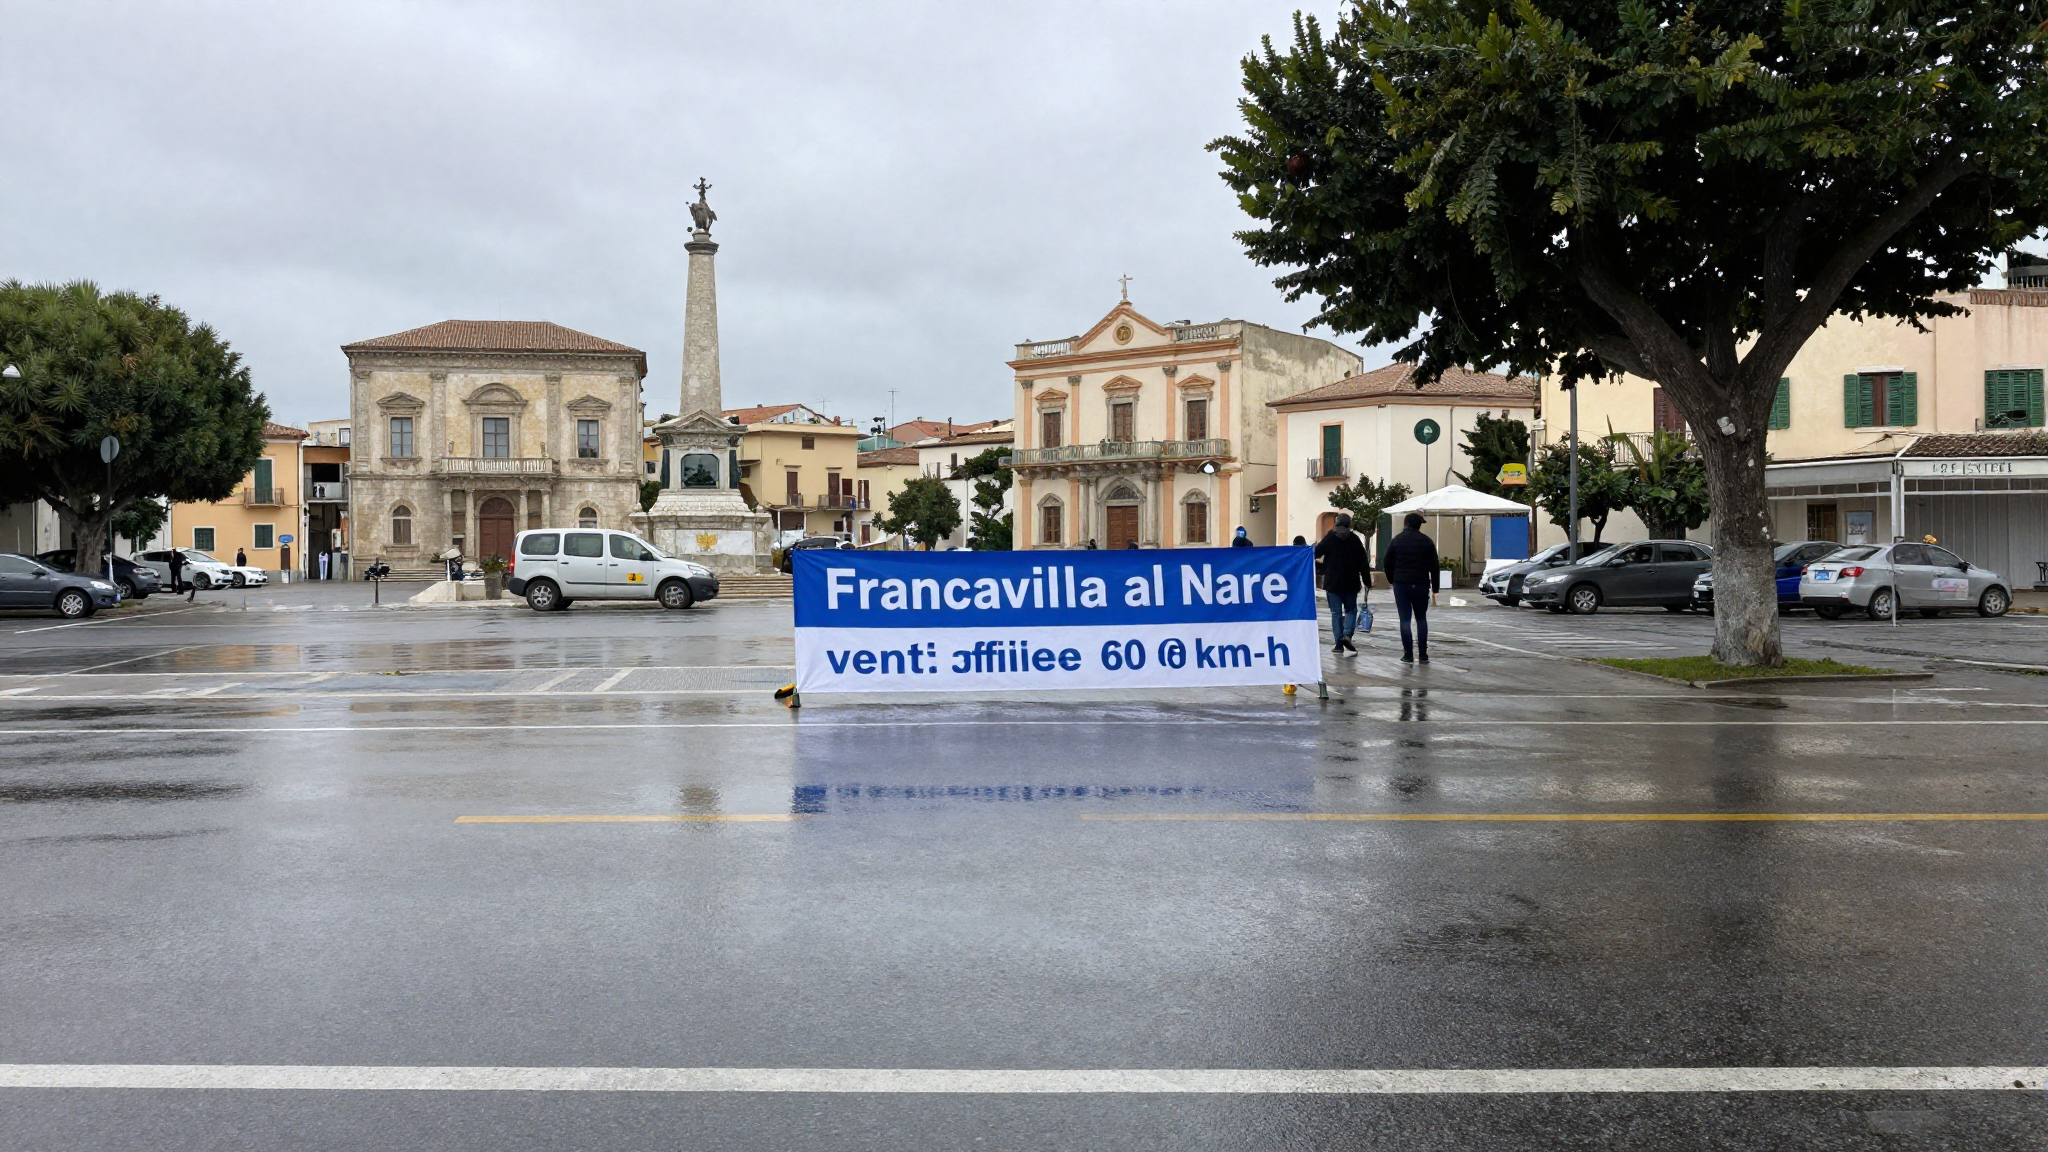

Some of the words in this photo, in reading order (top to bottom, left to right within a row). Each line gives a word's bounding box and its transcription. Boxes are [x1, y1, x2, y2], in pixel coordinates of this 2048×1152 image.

[826, 565, 1107, 611] Francavilla
[1124, 564, 1165, 608] al
[1180, 563, 1288, 606] Nare
[1101, 638, 1146, 671] 60
[1195, 635, 1291, 669] km-h
